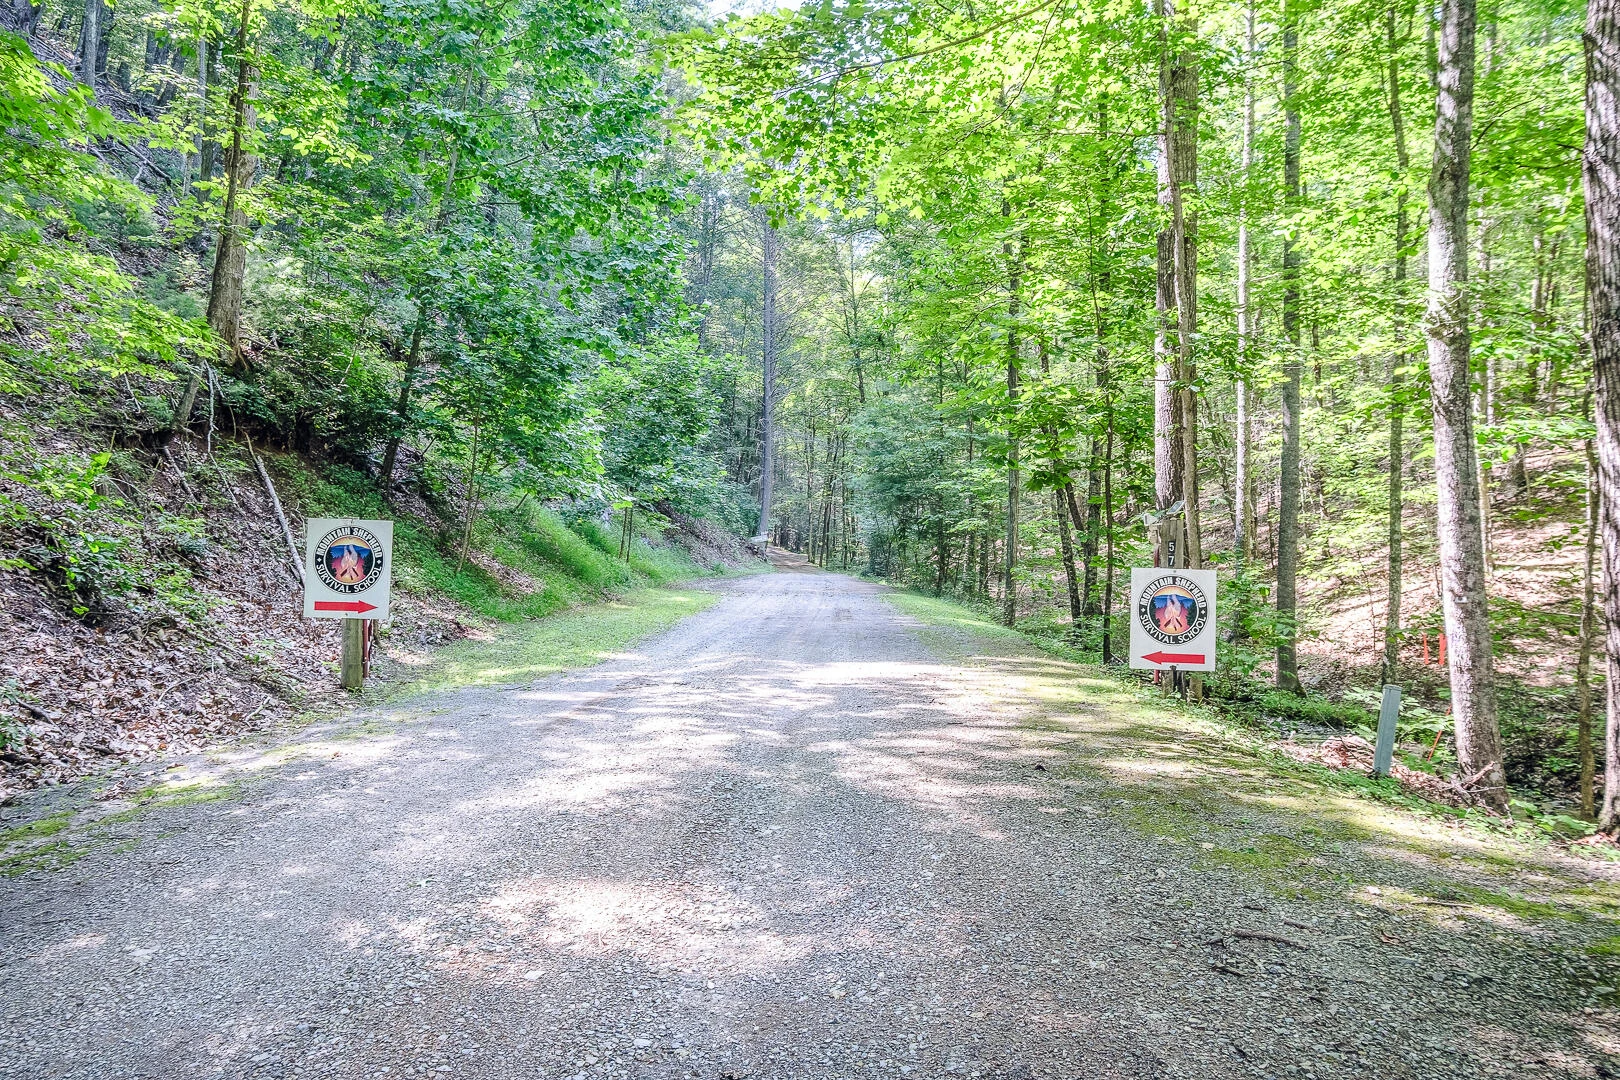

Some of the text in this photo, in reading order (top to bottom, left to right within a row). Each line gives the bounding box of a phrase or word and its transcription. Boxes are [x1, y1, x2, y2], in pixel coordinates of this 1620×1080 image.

[316, 527, 383, 558] MOUNTAIN SHEPHERD
[316, 564, 382, 593] SURVIVAL SCHOOL
[1140, 576, 1207, 608] MOUNTAIN SHEPHERD
[1140, 615, 1207, 644] SURVIVAL SCHOOL
